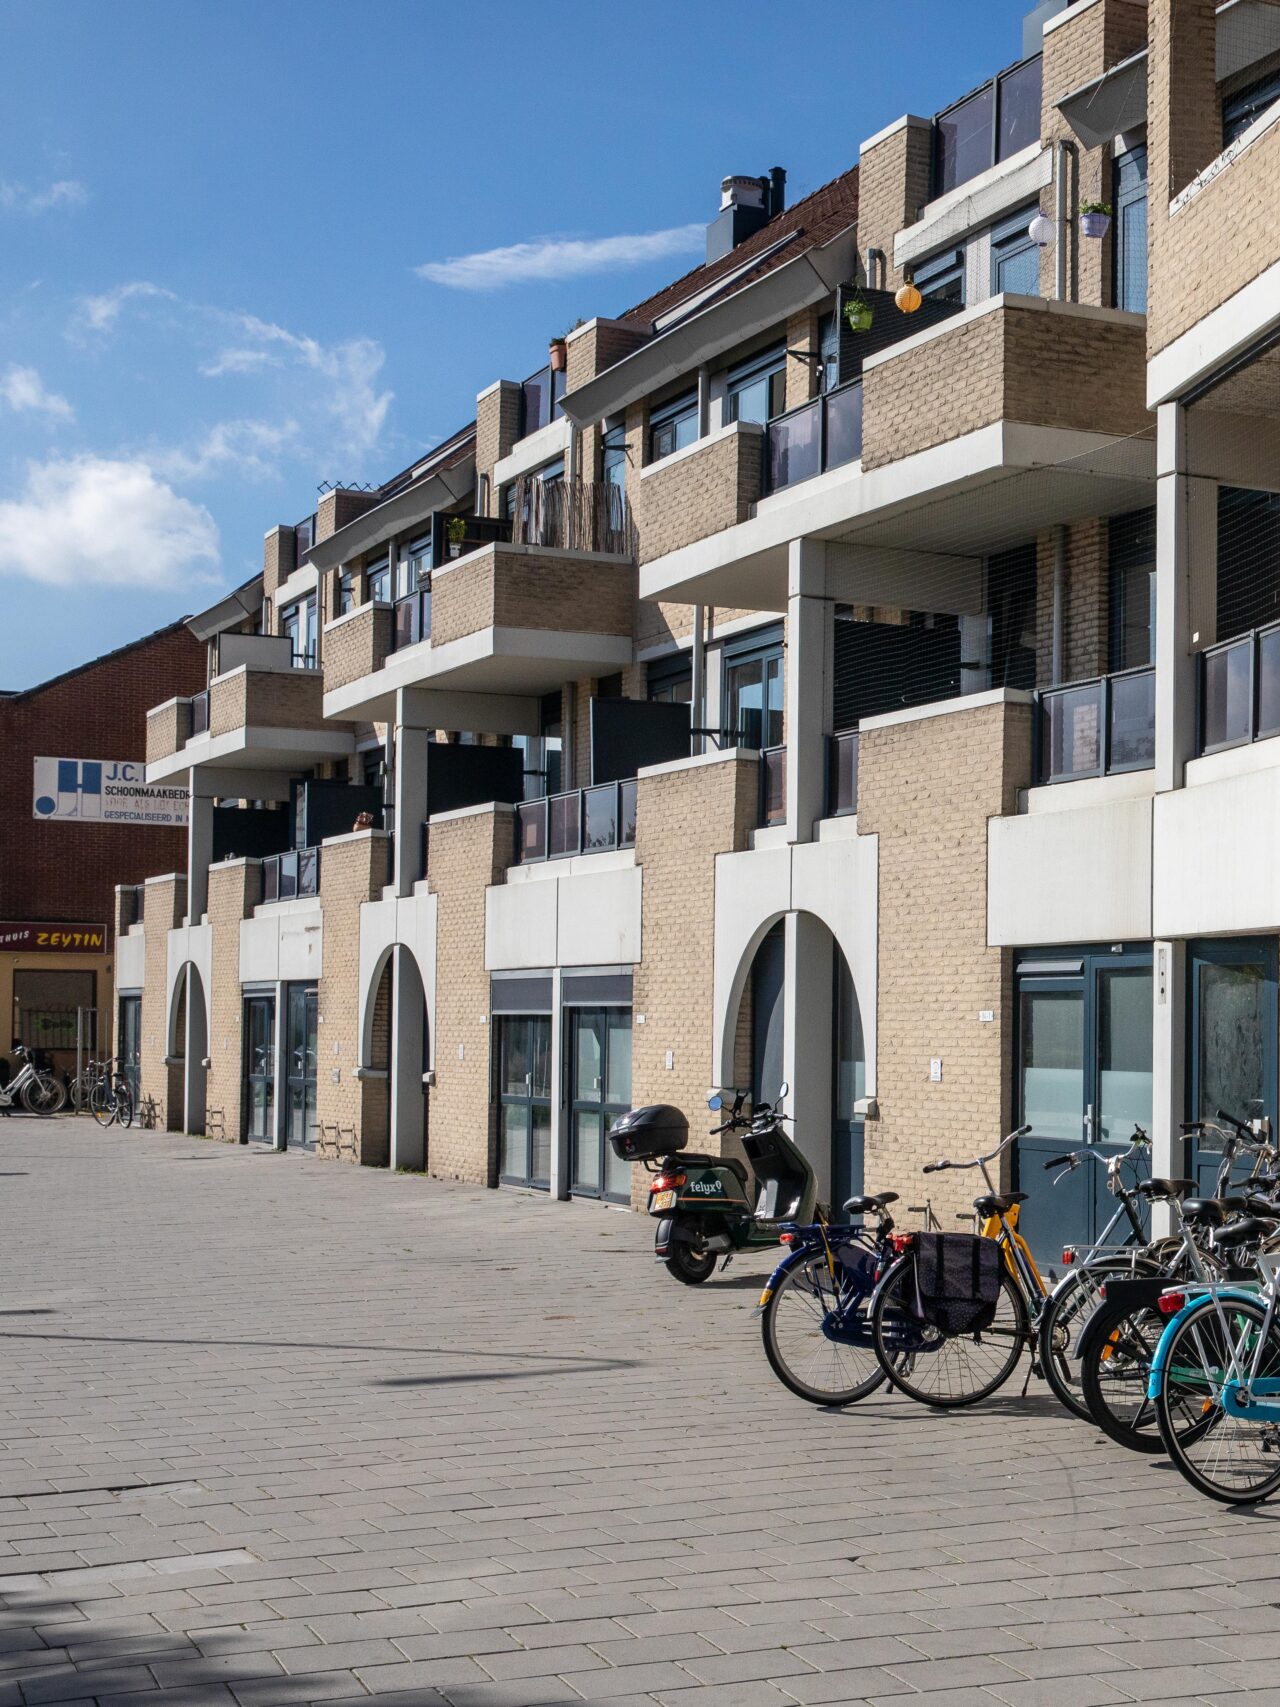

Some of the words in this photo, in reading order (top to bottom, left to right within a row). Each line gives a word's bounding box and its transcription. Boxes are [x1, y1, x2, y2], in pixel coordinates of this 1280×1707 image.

[104, 810, 172, 822] GESPECIALISEERD
[36, 932, 103, 947] ZEYTIN
[690, 1181, 717, 1195] felyx
